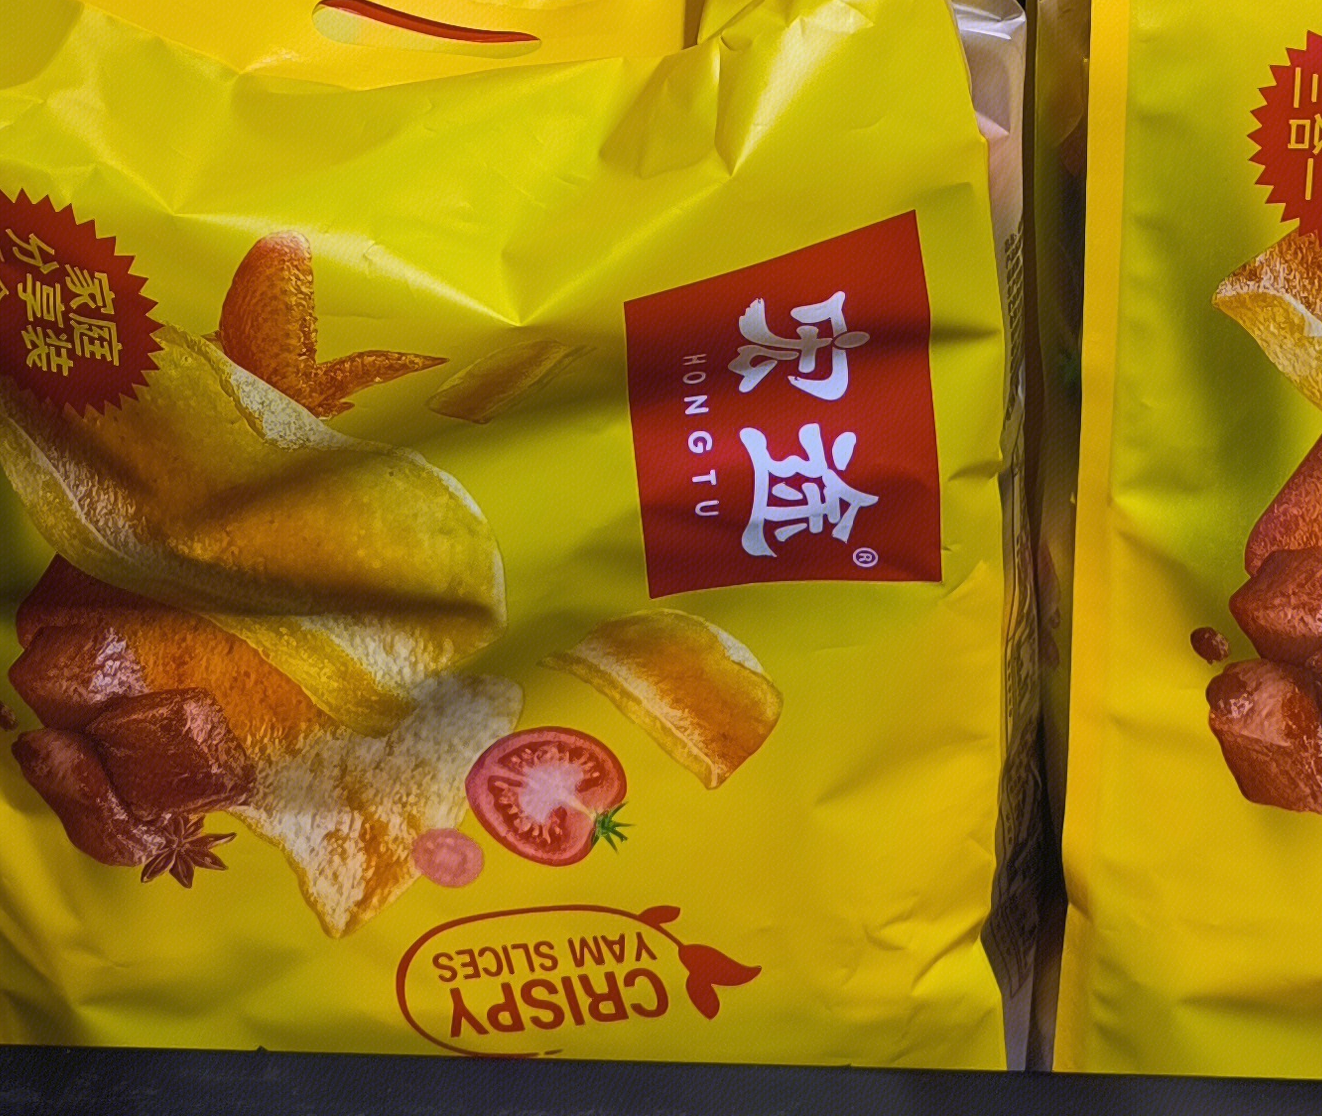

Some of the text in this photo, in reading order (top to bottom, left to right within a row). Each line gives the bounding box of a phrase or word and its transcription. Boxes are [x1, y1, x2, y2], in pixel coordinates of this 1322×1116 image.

[682, 353, 719, 517] HONGTU
[728, 291, 879, 557] 宏途
[432, 932, 657, 982] YAM SLICES
[450, 967, 670, 1038] CRISPY
